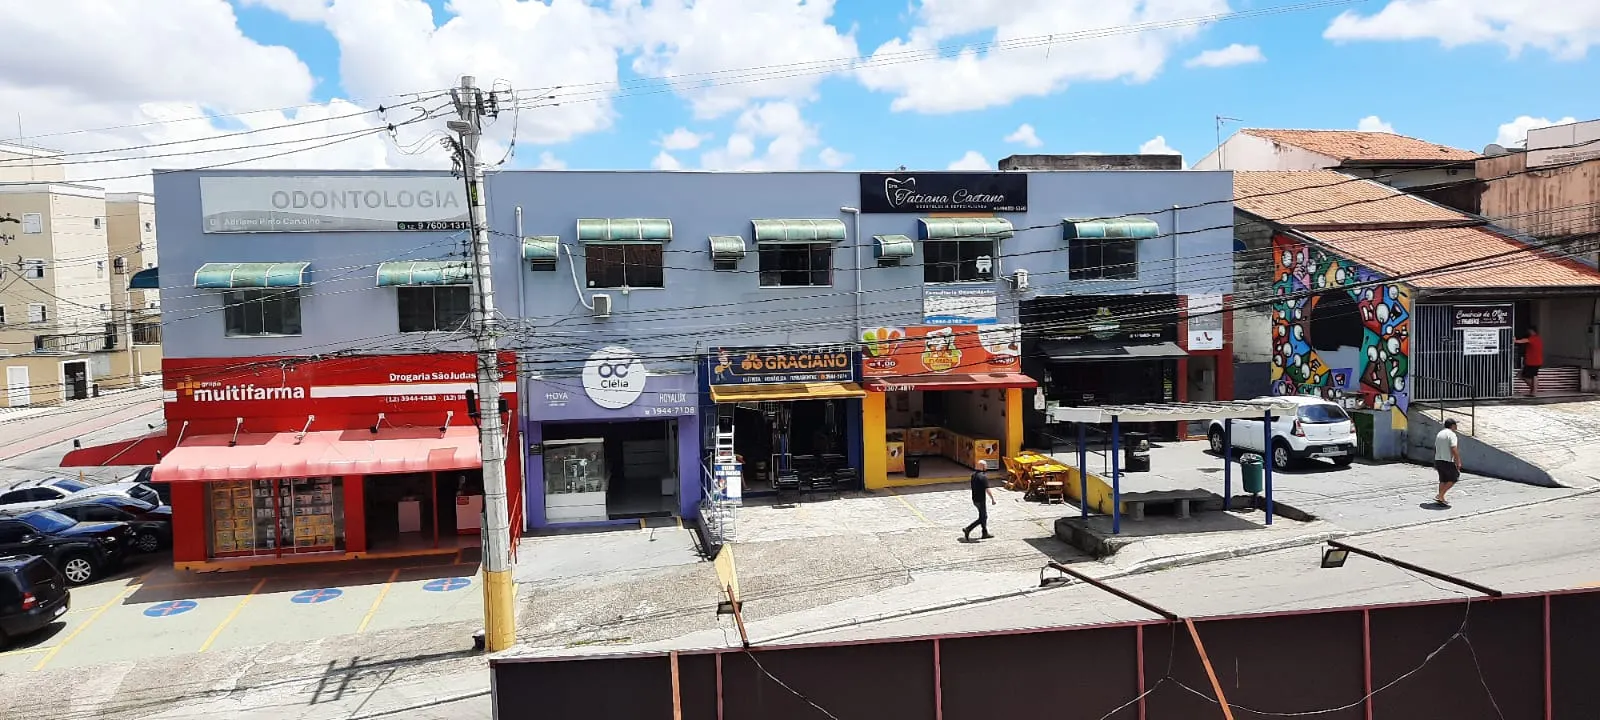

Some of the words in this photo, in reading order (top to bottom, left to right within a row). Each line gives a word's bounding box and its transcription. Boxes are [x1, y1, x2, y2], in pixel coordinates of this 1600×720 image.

[271, 190, 459, 210] ODONTOLOGIA
[895, 188, 949, 206] Tatiana
[952, 188, 1004, 204] Caetano
[224, 218, 258, 226] Adriano
[282, 217, 320, 226] Carvalho
[764, 353, 848, 370] GRACIANO
[389, 373, 431, 382] Drogaria
[600, 379, 629, 389] Clélia
[193, 383, 305, 402] multifarma
[545, 392, 569, 400] HOYA
[659, 392, 686, 403] HOYALUX
